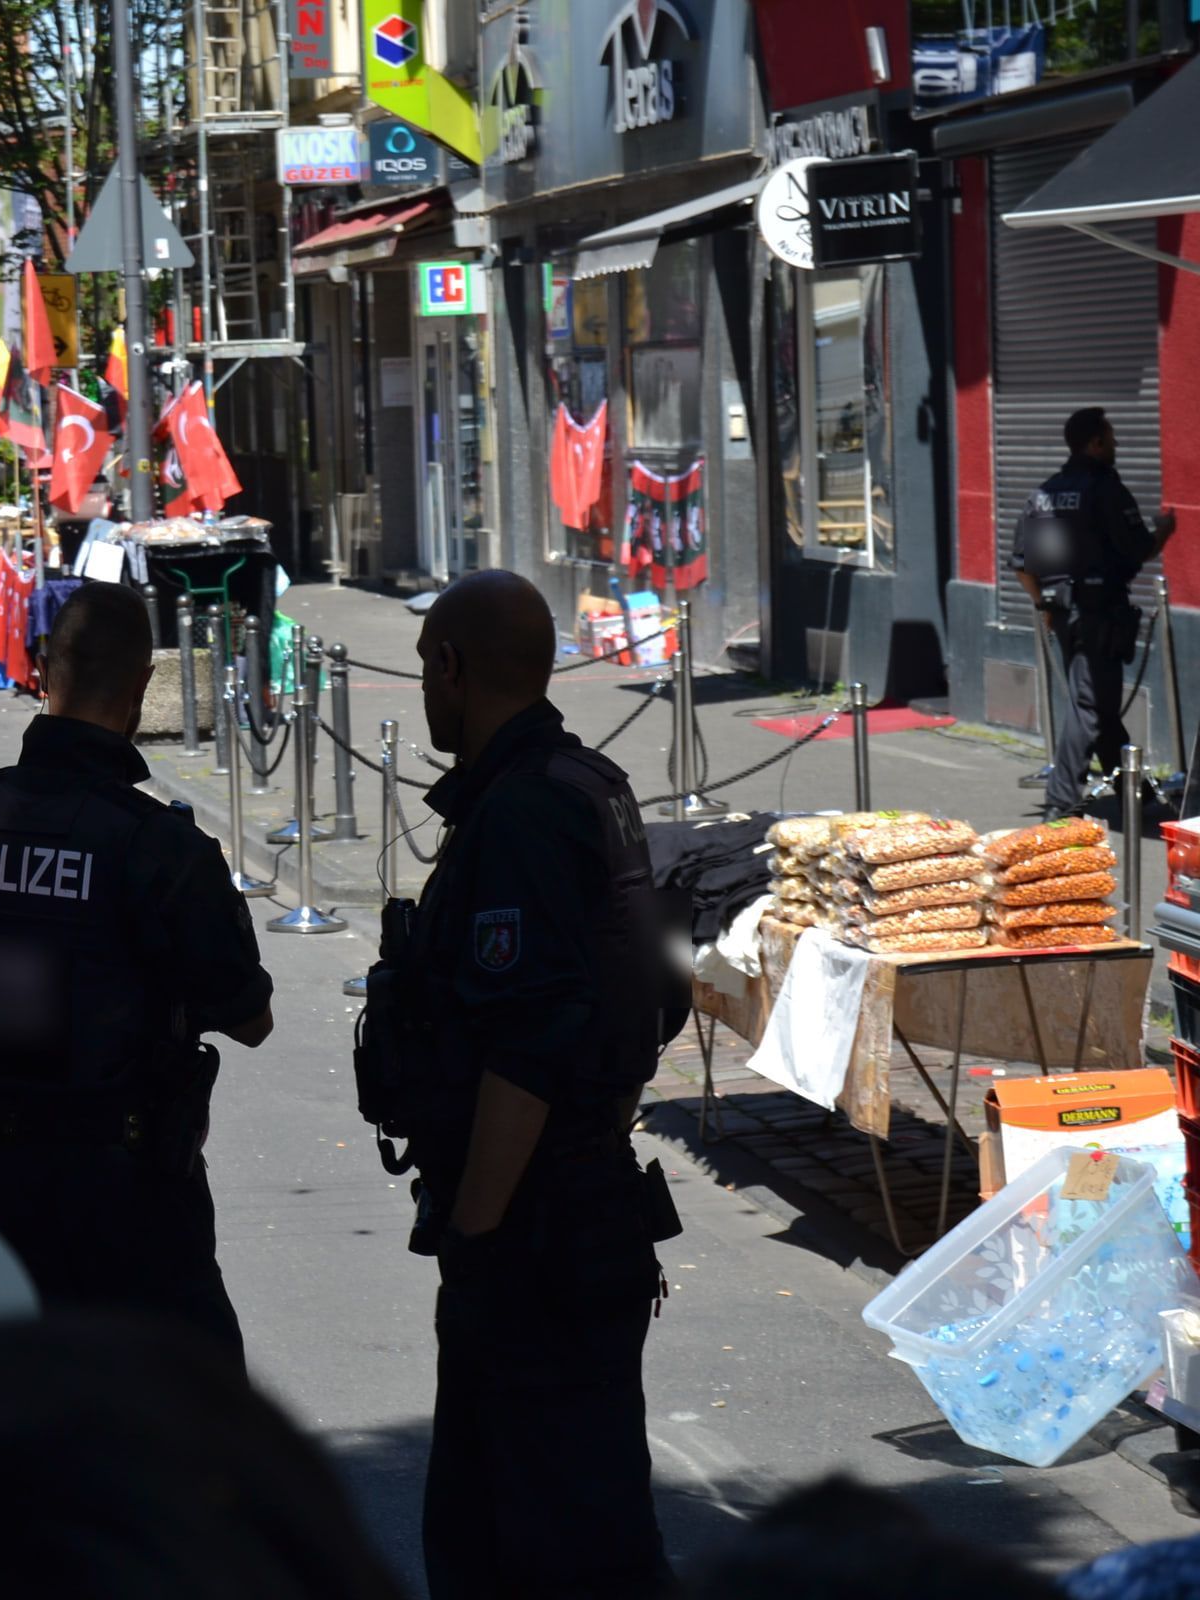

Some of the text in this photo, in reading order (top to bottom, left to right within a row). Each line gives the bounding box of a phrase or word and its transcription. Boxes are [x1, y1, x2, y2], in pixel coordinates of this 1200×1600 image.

[284, 132, 355, 164] KIOSK
[285, 166, 355, 183] GÜZEL
[375, 158, 427, 173] IQOS
[429, 267, 465, 303] EC
[1036, 492, 1080, 512] POLIZEI
